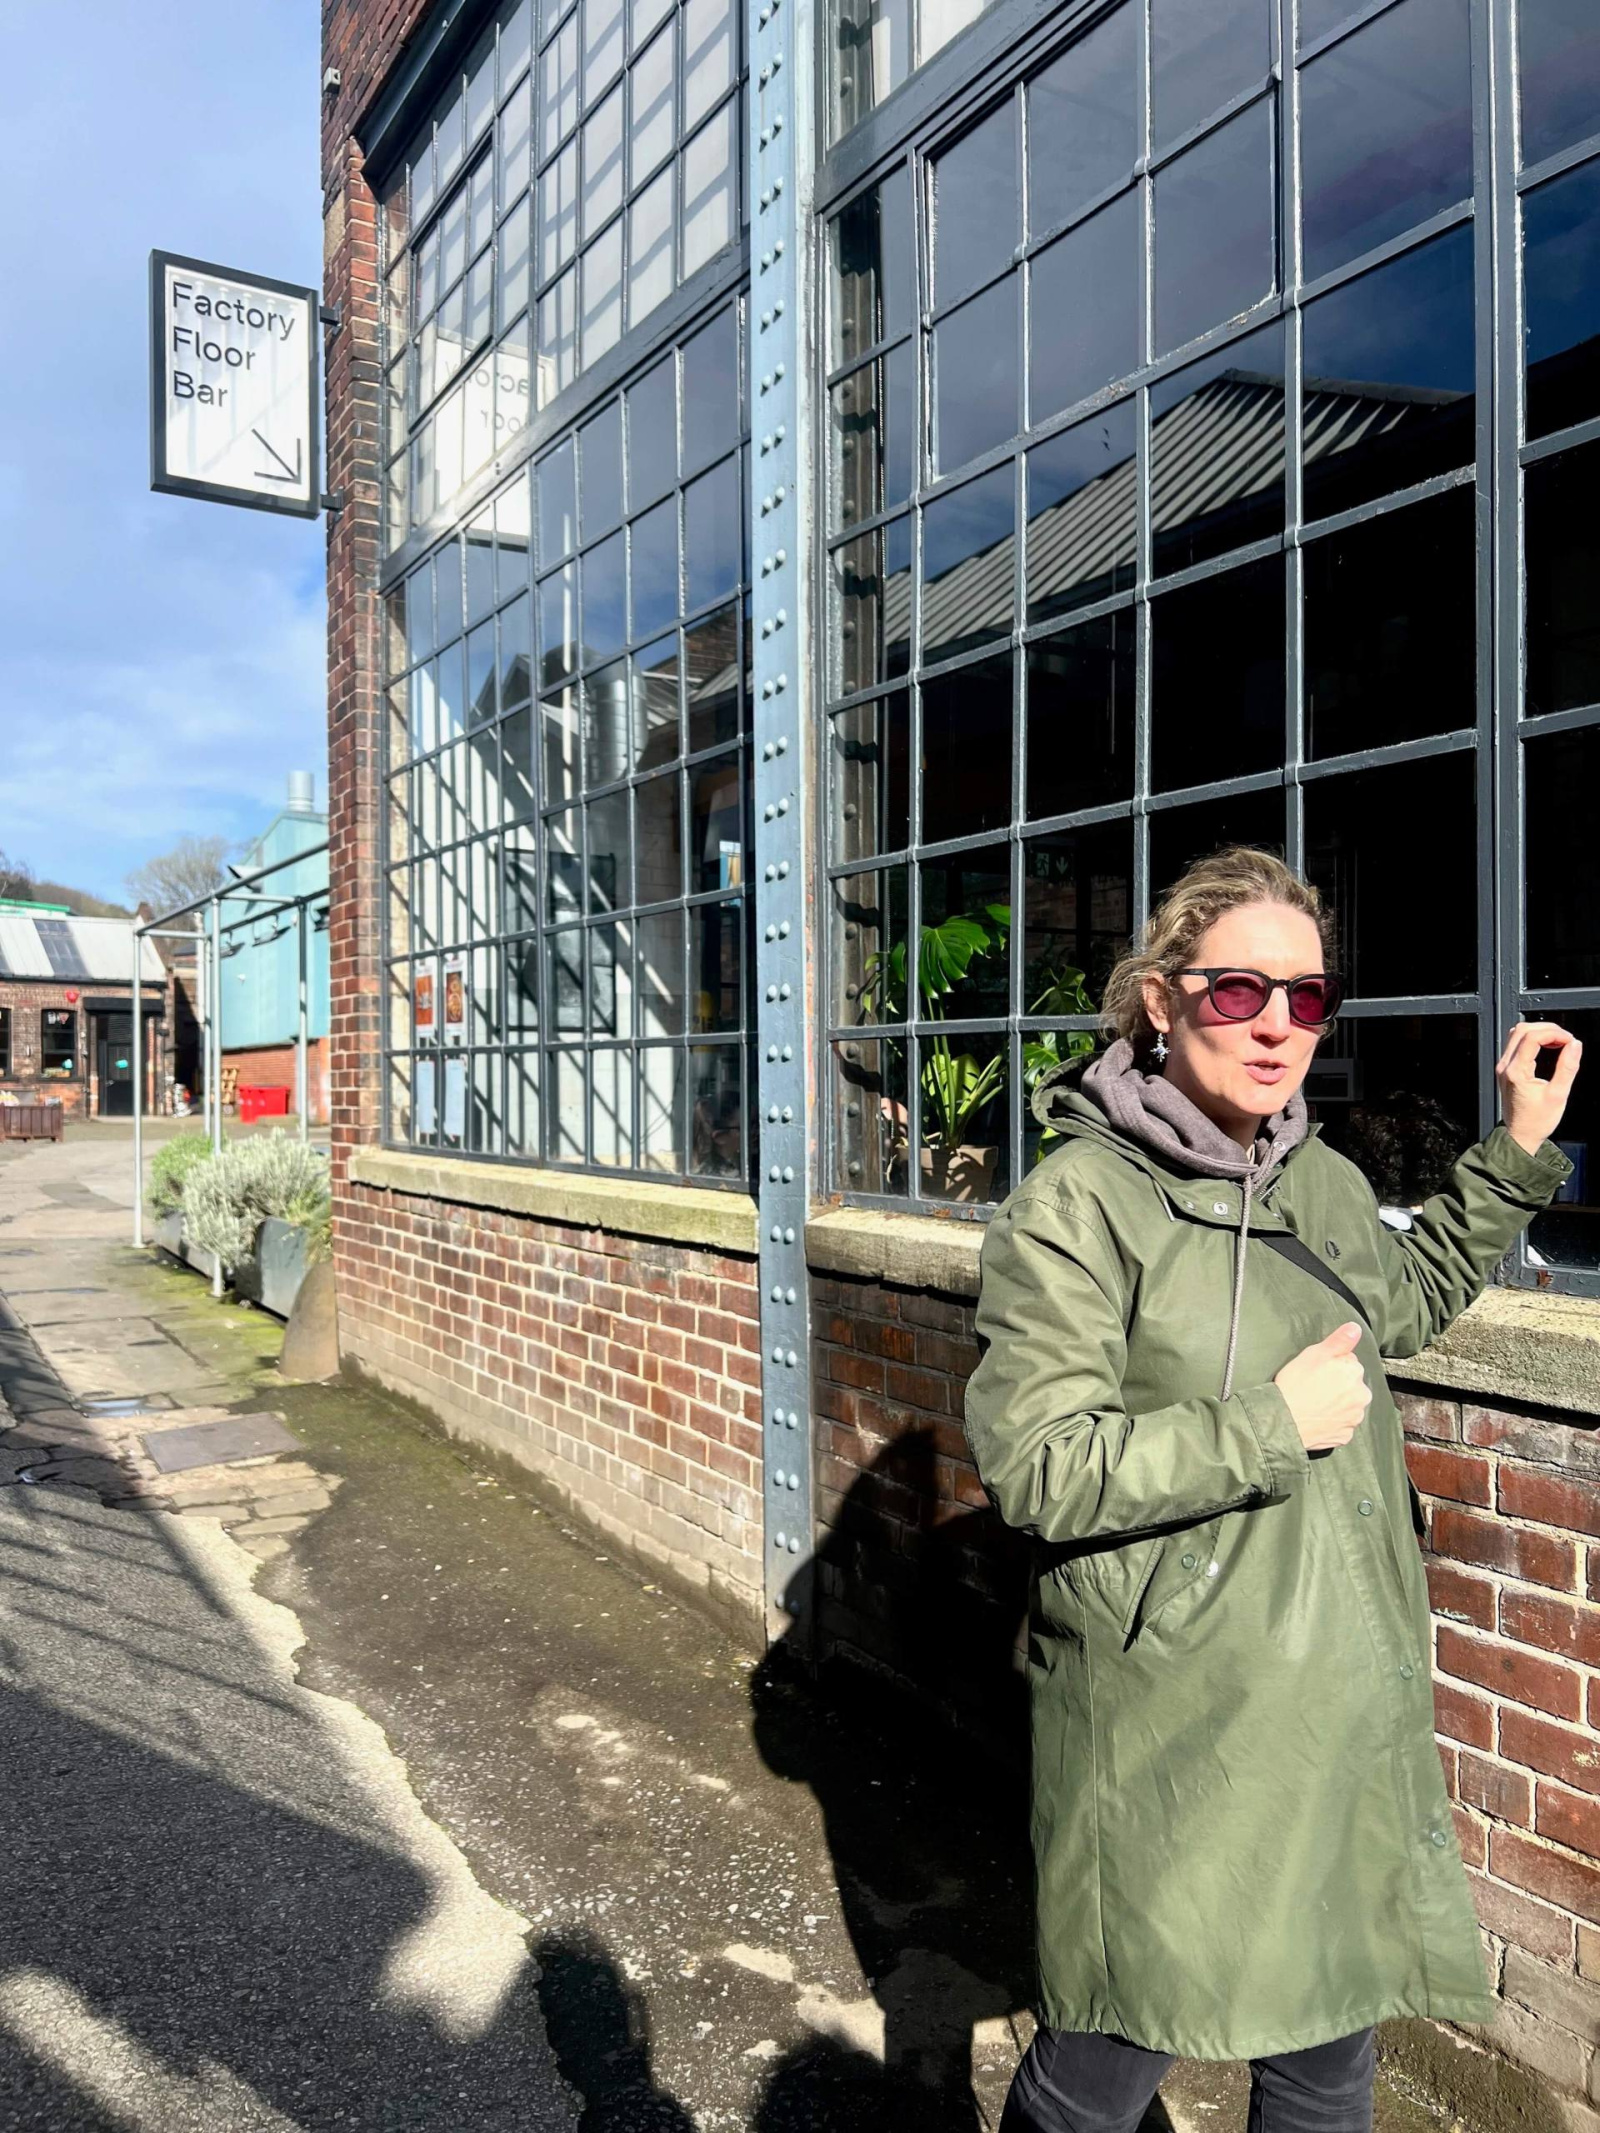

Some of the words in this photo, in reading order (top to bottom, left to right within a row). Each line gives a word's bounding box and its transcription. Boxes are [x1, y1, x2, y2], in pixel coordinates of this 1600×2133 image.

[173, 281, 295, 341] Factory
[173, 326, 256, 370] Floor
[173, 370, 228, 407] Bar
